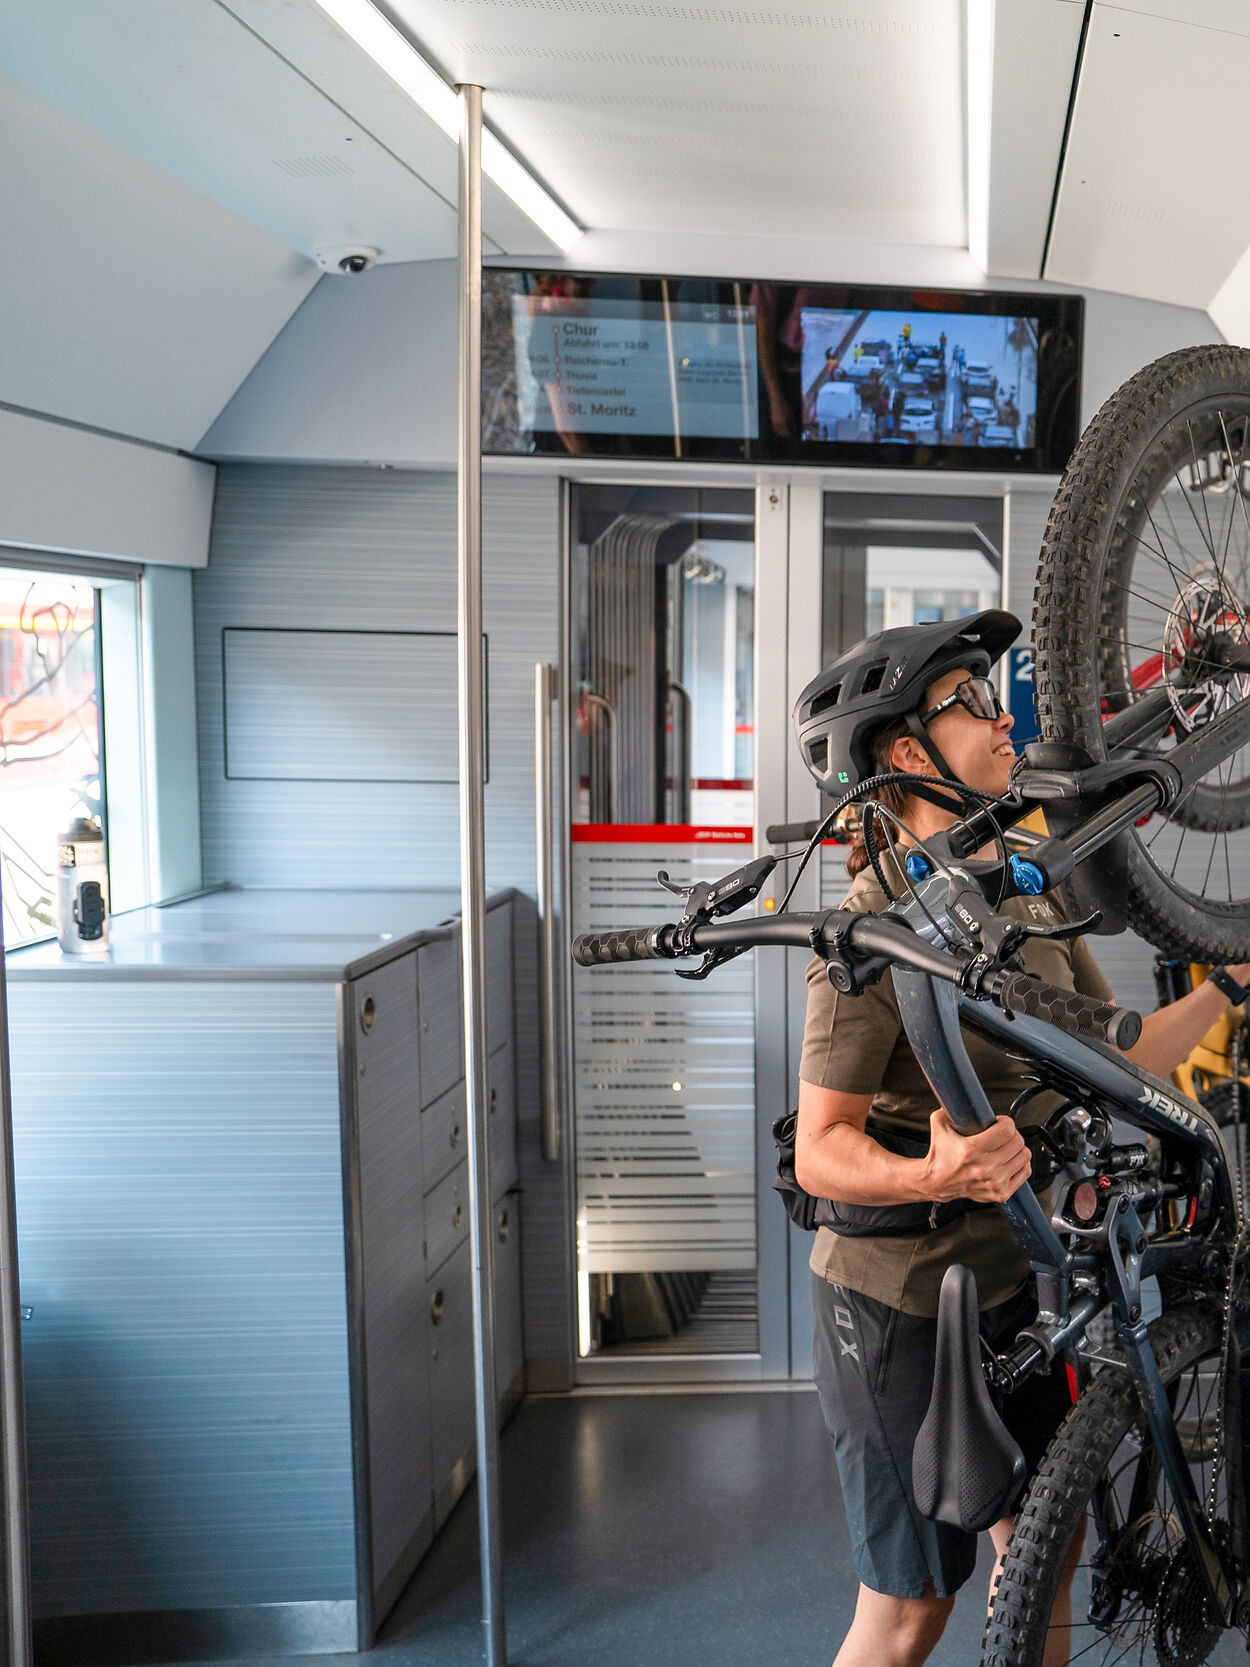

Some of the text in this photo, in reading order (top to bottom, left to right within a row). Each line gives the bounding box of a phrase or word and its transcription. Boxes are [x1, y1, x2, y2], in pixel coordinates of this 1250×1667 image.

[562, 322, 598, 337] Chur
[563, 338, 600, 350] Abfahrt
[565, 371, 598, 382] Thusis
[566, 386, 626, 397] Tiefencastel
[567, 402, 588, 417] St.
[590, 403, 637, 418] Moritz
[1015, 650, 1035, 681] 2
[1027, 902, 1055, 919] FOX
[1137, 1085, 1199, 1136] TREK
[826, 1280, 860, 1361] FOX
